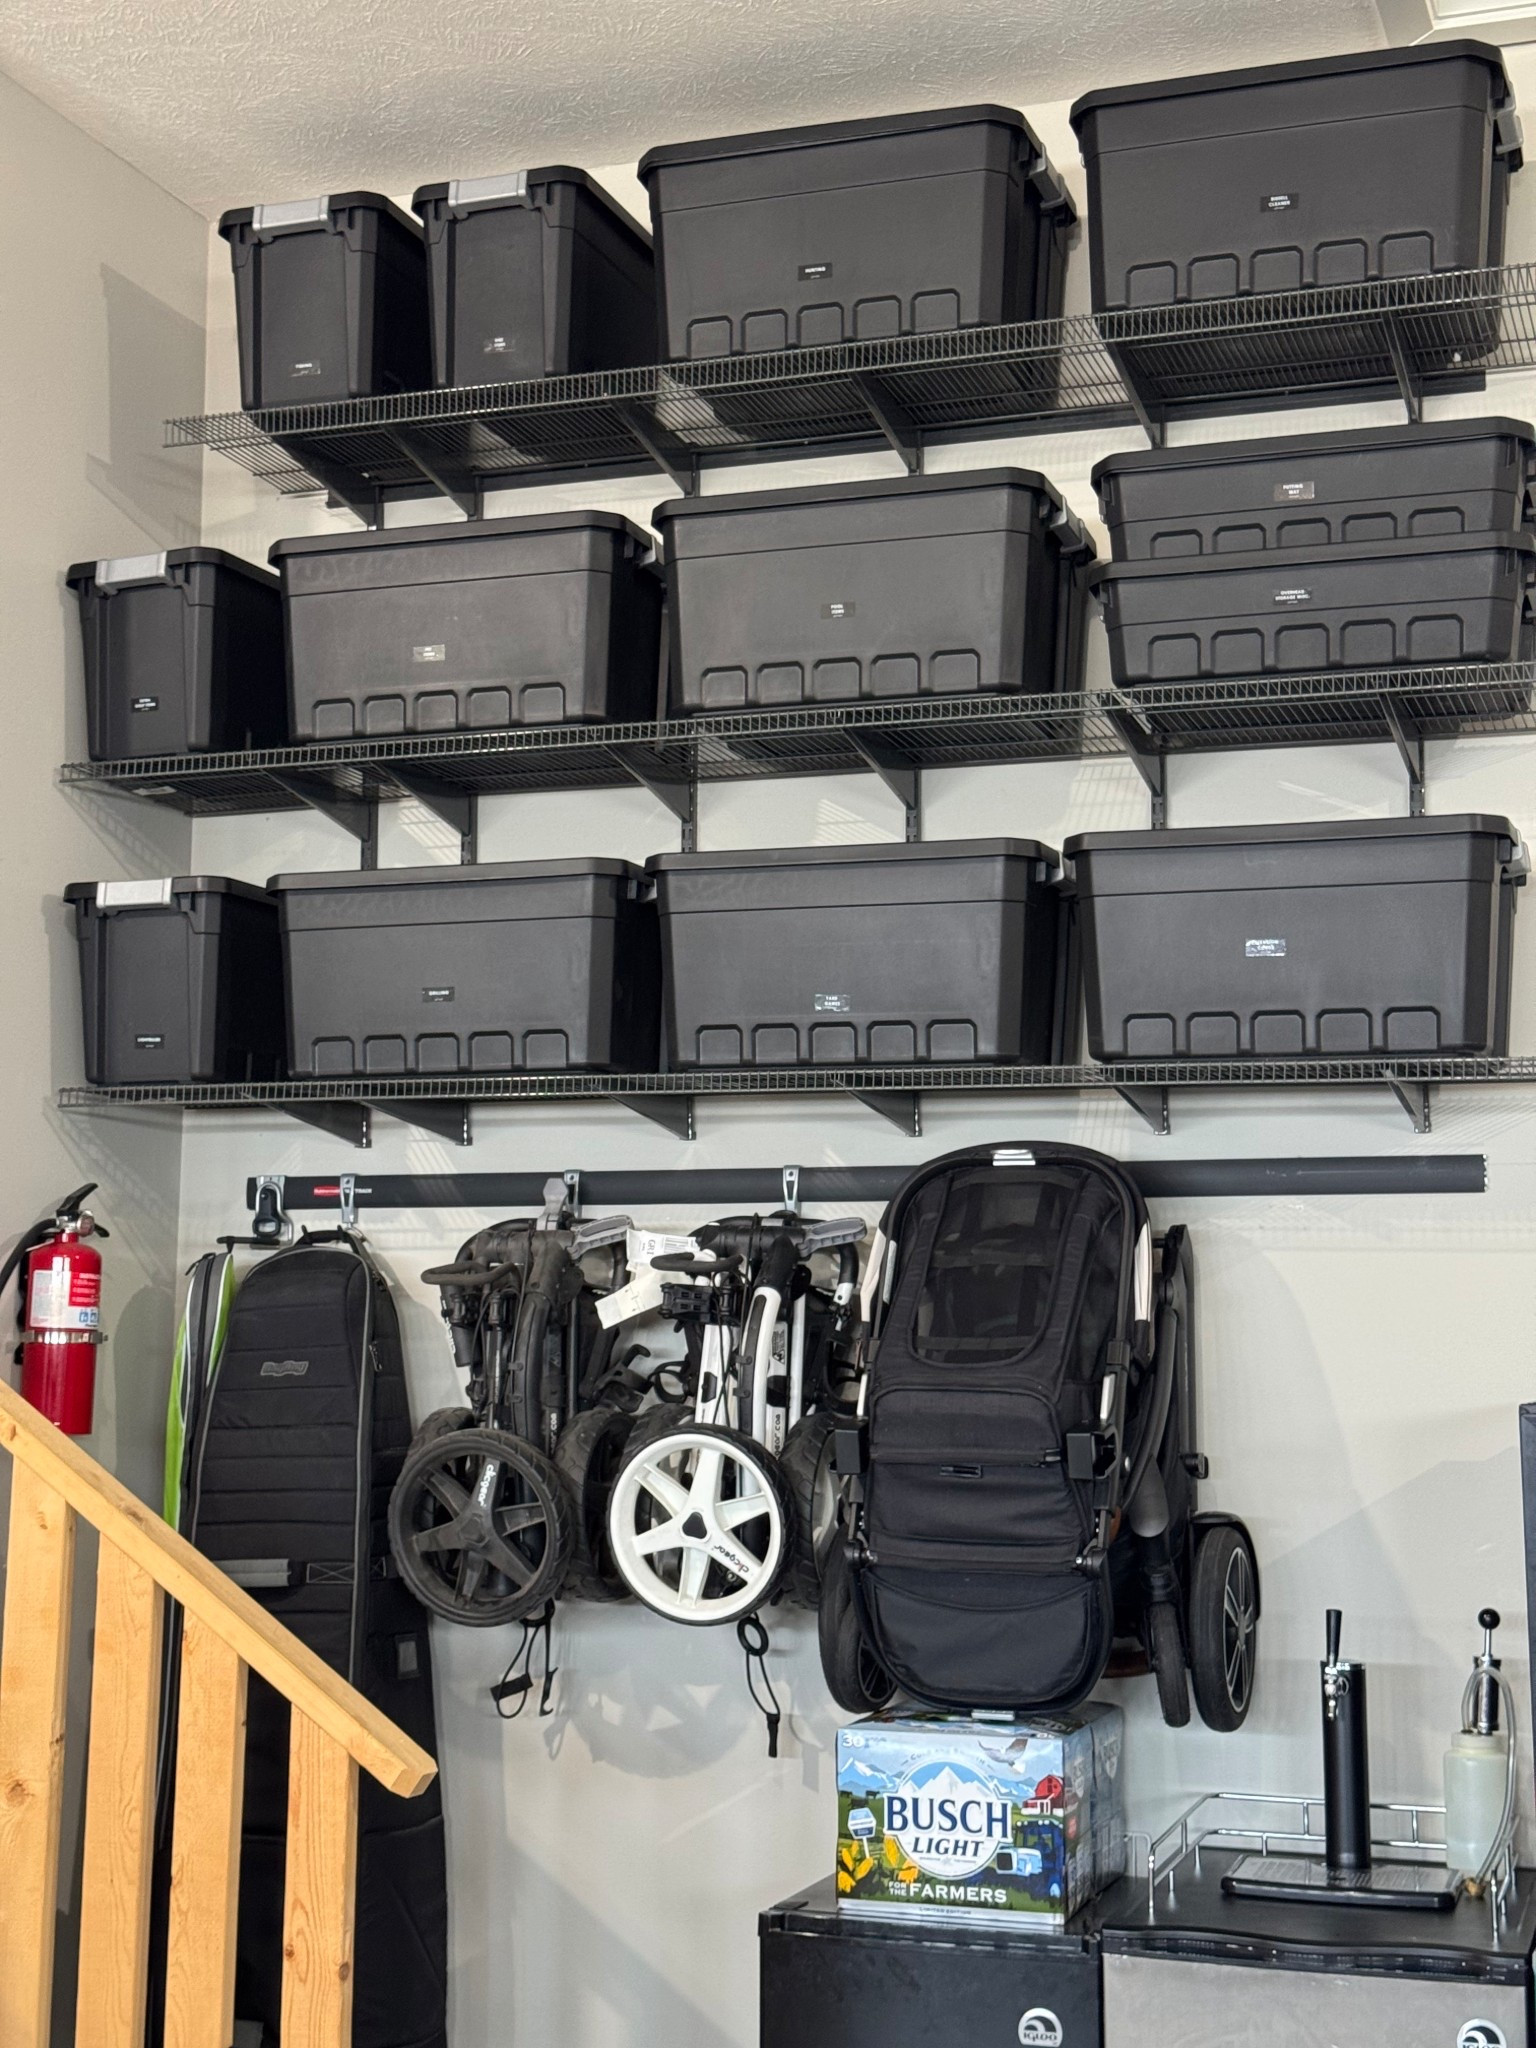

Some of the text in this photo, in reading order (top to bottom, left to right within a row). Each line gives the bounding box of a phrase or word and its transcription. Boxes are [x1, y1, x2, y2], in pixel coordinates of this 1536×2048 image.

[478, 1464, 496, 1507] clicgear
[713, 1543, 750, 1574] clicgear
[886, 1795, 1010, 1839] BUSCH
[911, 1837, 984, 1858] LIGHT
[889, 1881, 906, 1889] FOR
[889, 1887, 907, 1896] THE
[910, 1882, 1007, 1903] FARMERS
[1023, 2032, 1057, 2042] IGLOO
